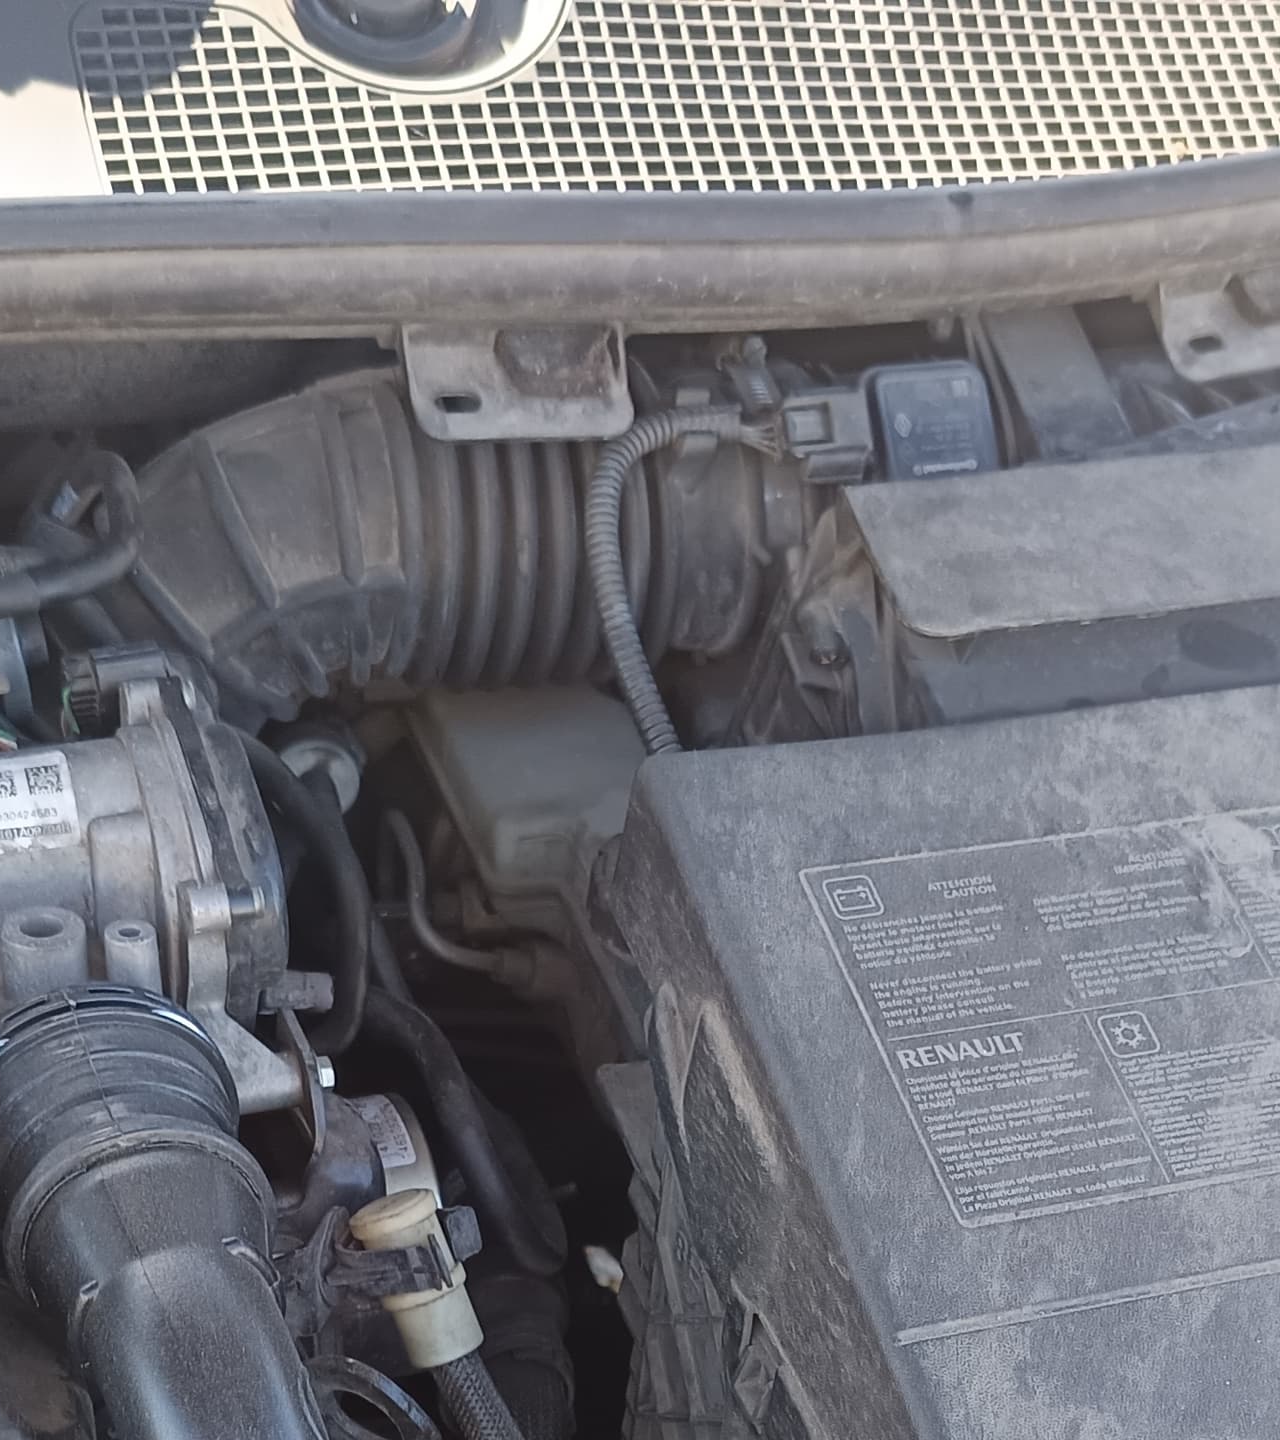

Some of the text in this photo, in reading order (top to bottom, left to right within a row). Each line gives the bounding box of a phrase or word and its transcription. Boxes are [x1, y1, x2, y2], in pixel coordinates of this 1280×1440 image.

[927, 876, 992, 891] ATTENTION
[943, 886, 996, 899] CAUTION
[870, 980, 899, 990] Never
[902, 972, 955, 985] disconnect
[975, 964, 1009, 975] battery
[879, 998, 912, 1010] Before
[936, 986, 995, 1001] intervention
[893, 987, 927, 997] engine
[883, 1008, 918, 1019] battery
[921, 1003, 953, 1014] please
[896, 1032, 1023, 1070] RENAULT
